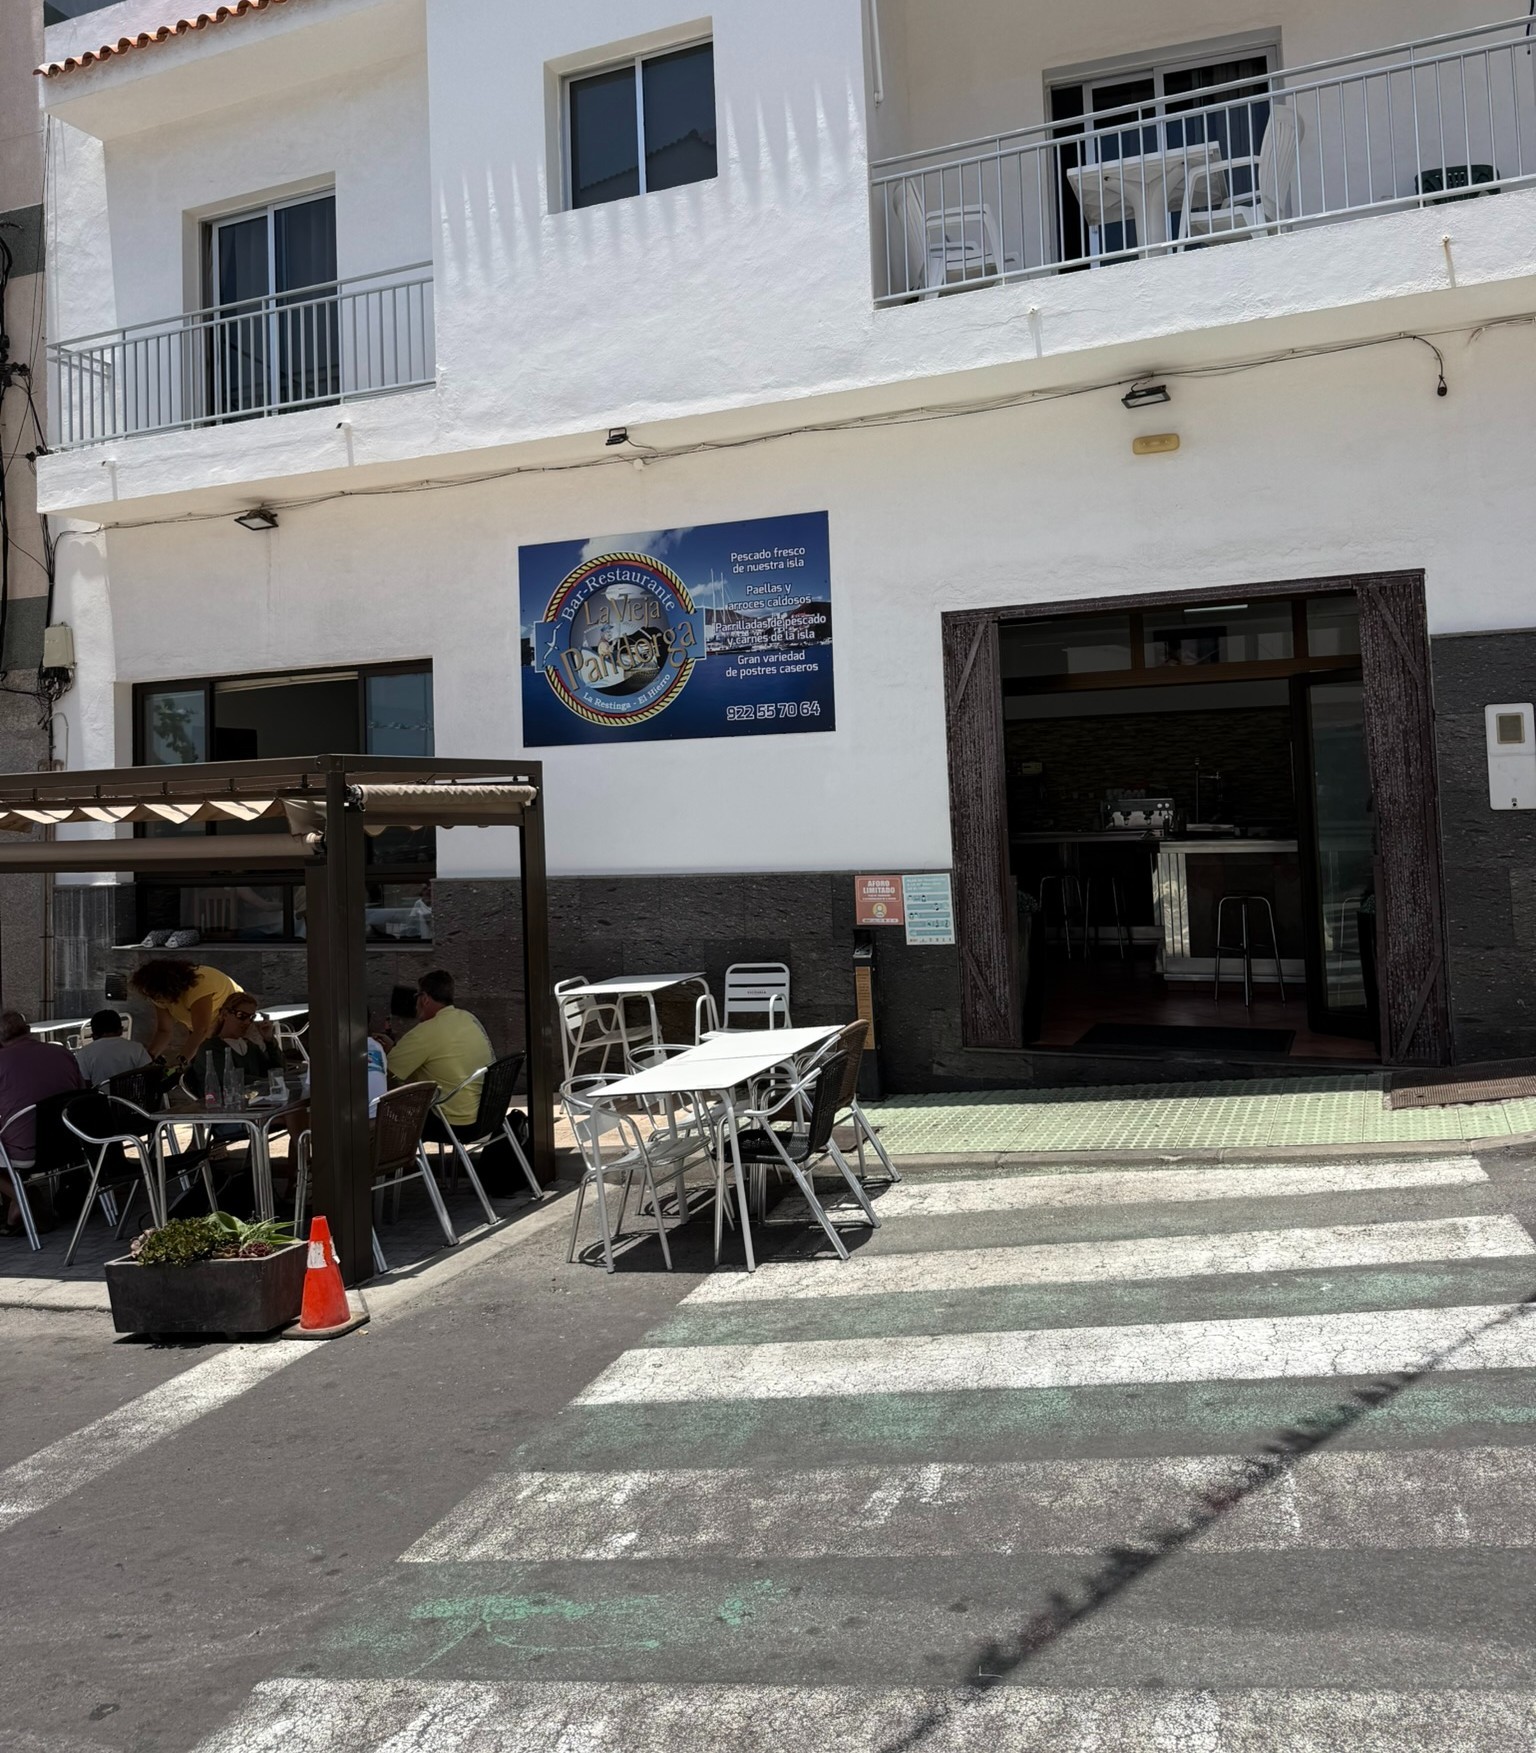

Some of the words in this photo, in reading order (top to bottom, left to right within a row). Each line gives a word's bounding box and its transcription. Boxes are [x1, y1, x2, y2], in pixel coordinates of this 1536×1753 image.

[731, 549, 771, 562] Pescado
[774, 547, 805, 557] fresco
[733, 563, 744, 574] de
[747, 560, 784, 572] nuestra
[787, 557, 804, 568] isla
[561, 568, 675, 621] Bar-Restaurante
[746, 583, 782, 595] Paellas
[785, 583, 792, 593] y
[584, 600, 611, 626] La
[609, 593, 661, 629] Vieja
[728, 599, 765, 610] arroces
[767, 595, 811, 607] caldosos
[715, 619, 768, 632] Parrilladas
[770, 616, 782, 627] de
[785, 613, 826, 628] pescado
[727, 638, 733, 647] y
[736, 635, 769, 645] carnes
[771, 631, 783, 642] de
[785, 630, 795, 640] la
[797, 629, 815, 639] isla
[560, 620, 697, 691] Pandorga
[738, 655, 761, 665] Gran
[763, 650, 805, 662] variedad
[726, 667, 737, 677] de
[740, 665, 777, 679] postres
[780, 663, 818, 674] caseros
[583, 692, 593, 702] La
[594, 697, 632, 711] Restinga
[637, 694, 648, 705] El
[647, 674, 671, 698] Hierro
[726, 706, 755, 721] 922
[756, 703, 776, 719] 55
[777, 702, 798, 718] 70
[800, 701, 820, 717] 64
